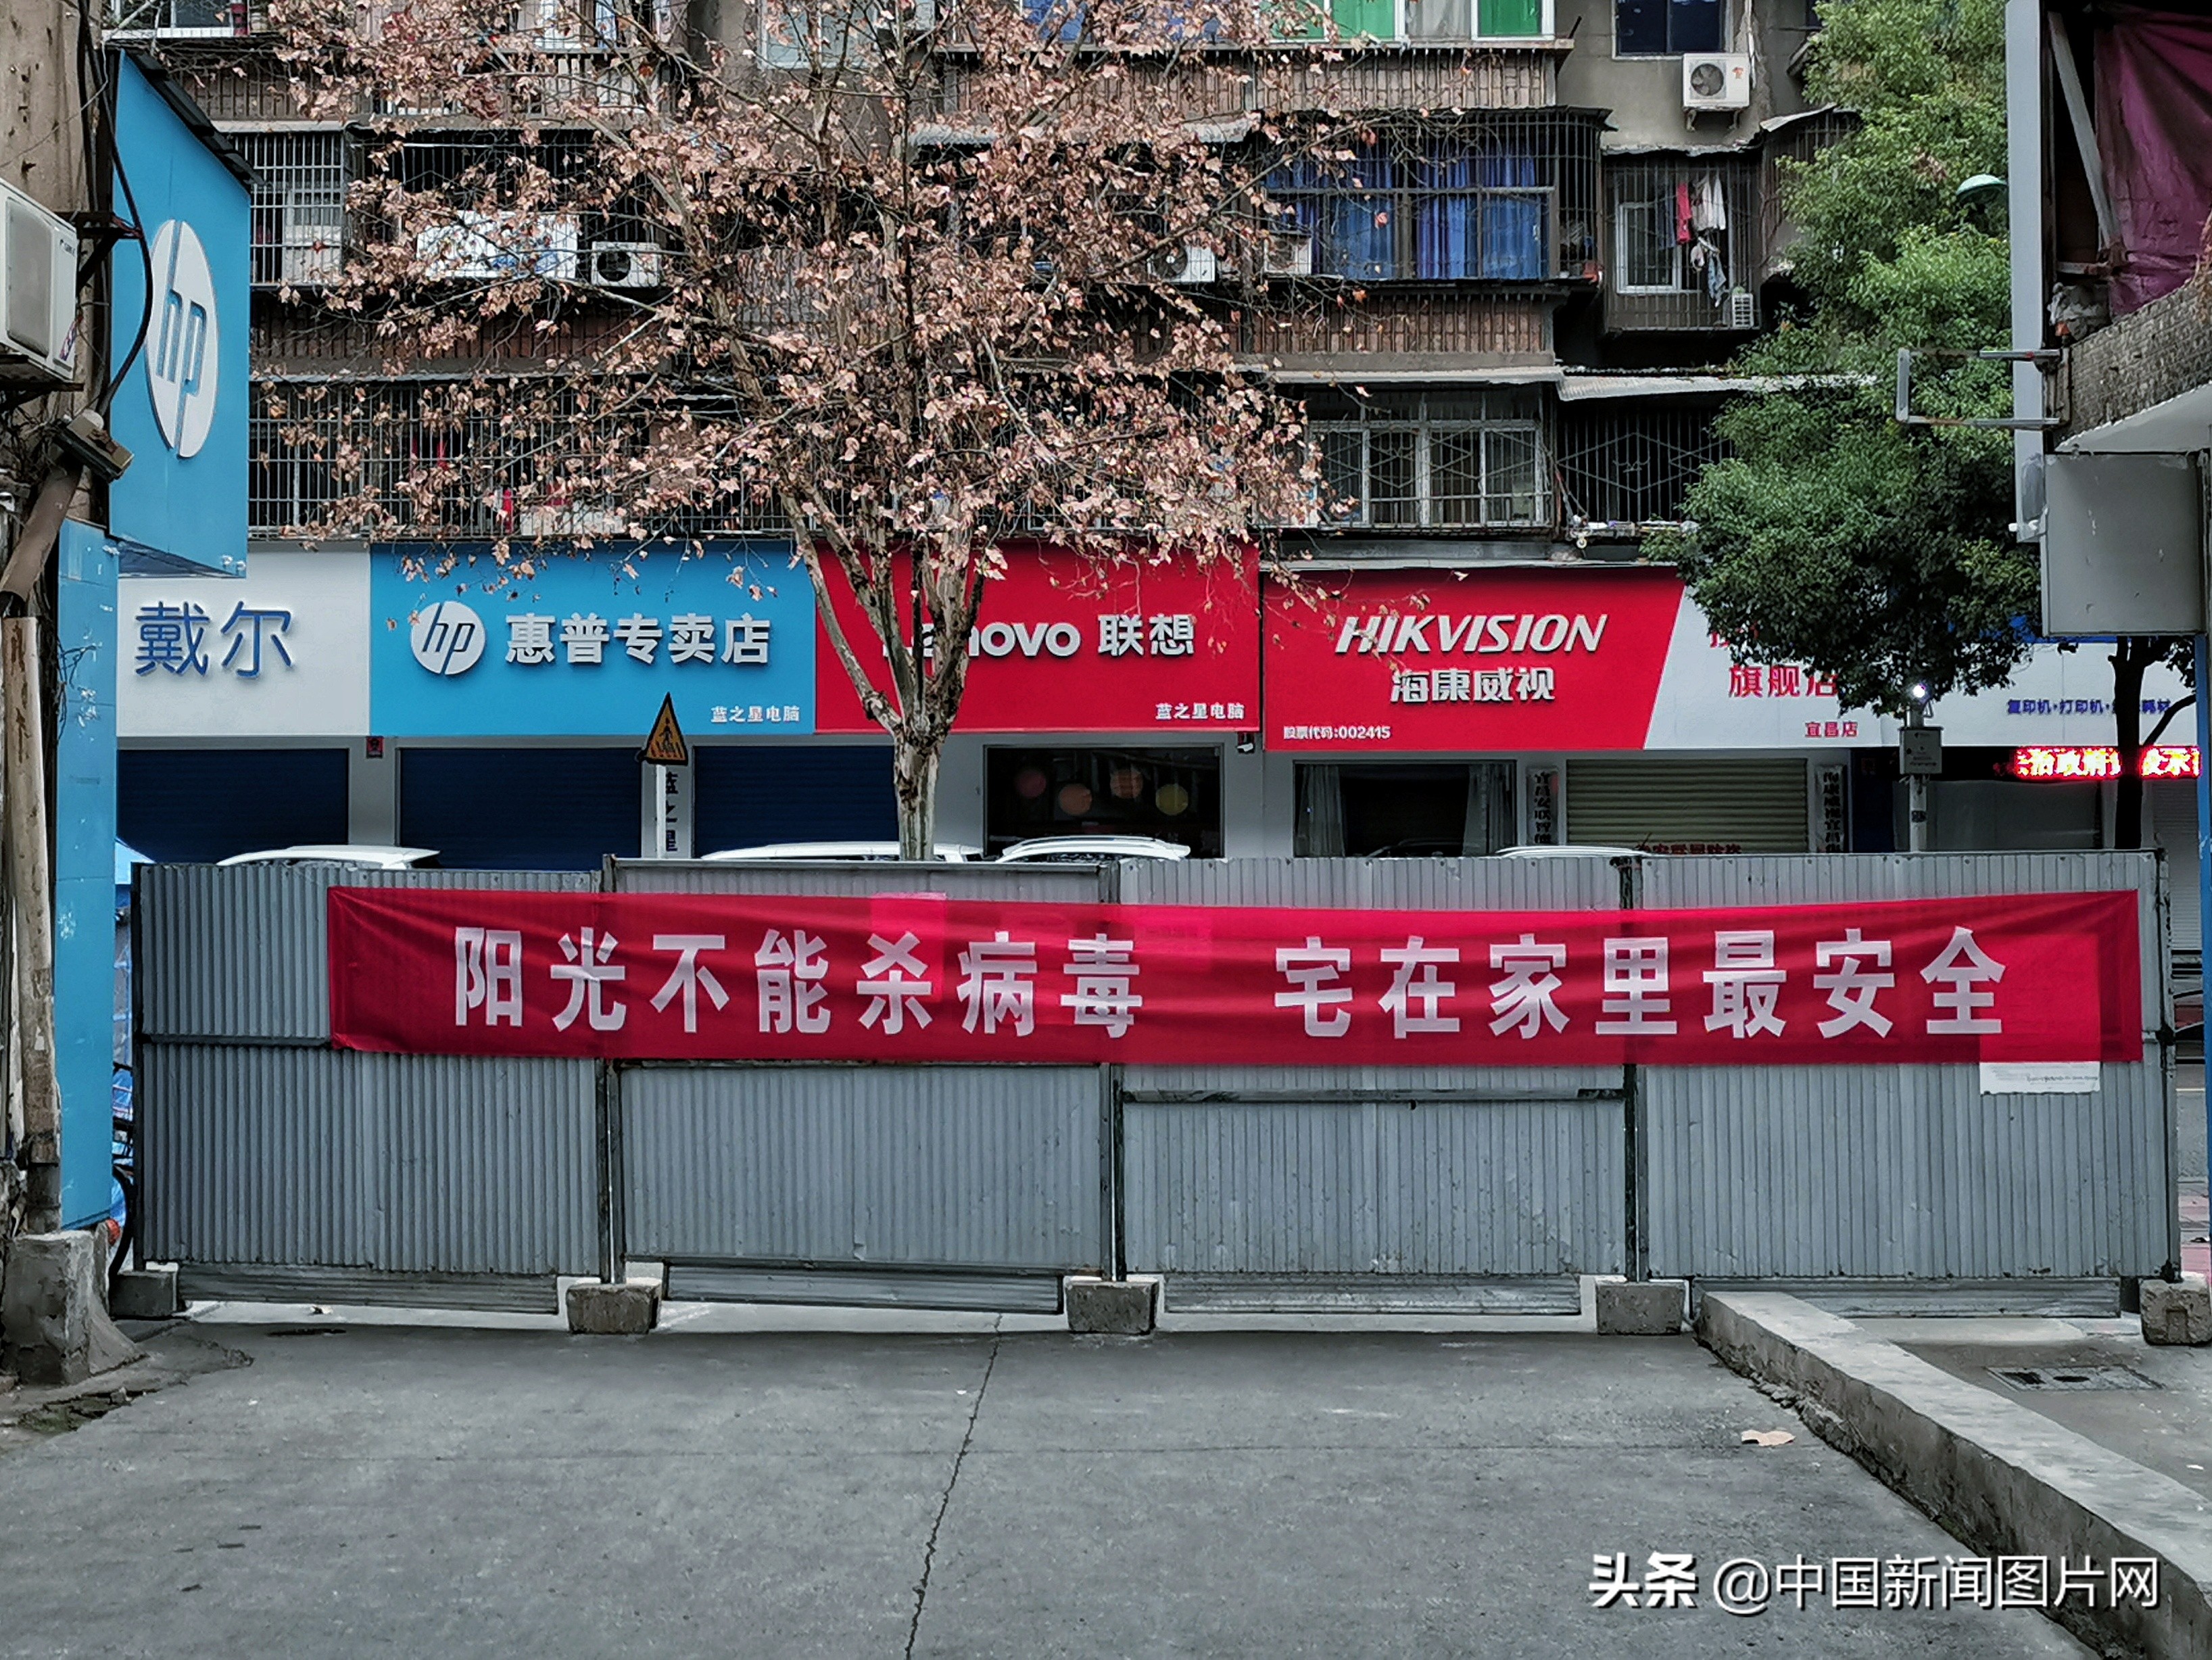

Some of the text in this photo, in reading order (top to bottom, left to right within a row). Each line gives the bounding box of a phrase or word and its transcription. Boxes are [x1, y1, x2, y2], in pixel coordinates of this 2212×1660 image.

[135, 600, 293, 678] 戴尔
[506, 613, 770, 664] 惠普专卖店
[883, 614, 1195, 657] eovo 联想
[1335, 613, 1608, 654] HIKVISION
[1391, 667, 1555, 703] 海康威视
[711, 705, 800, 723] 蓝之星电脑
[1155, 702, 1245, 721] 蓝之星电脑
[1805, 721, 1858, 737] 宜昌店
[454, 926, 2006, 1039] 阳光不能杀病毒 宅在家里最安全
